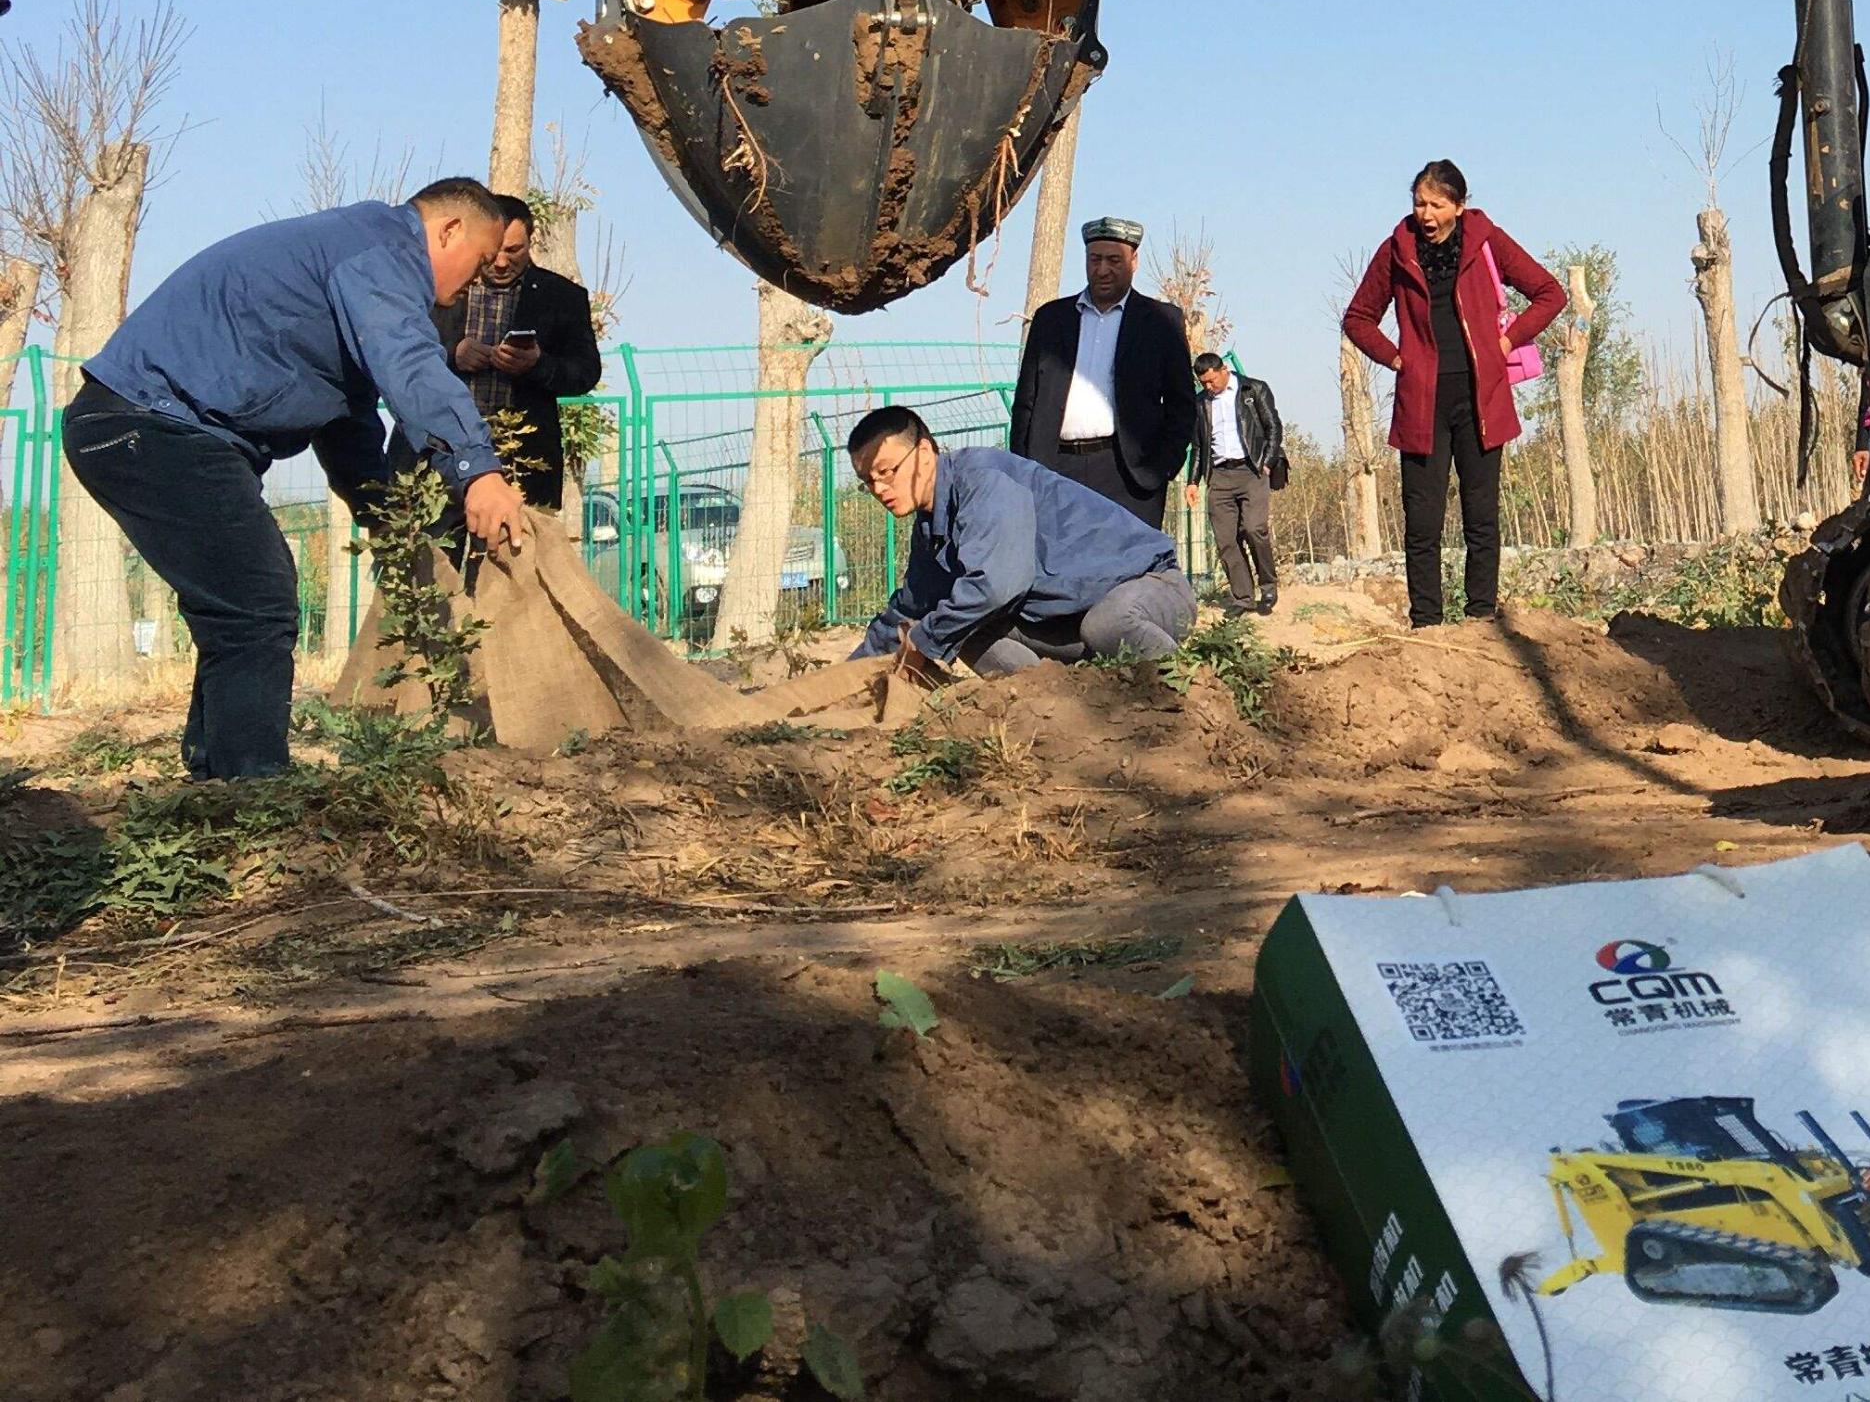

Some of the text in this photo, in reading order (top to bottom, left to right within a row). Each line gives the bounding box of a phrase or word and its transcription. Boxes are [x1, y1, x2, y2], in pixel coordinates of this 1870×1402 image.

[1588, 972, 1723, 1005] CQM
[1604, 999, 1736, 1026] 常青机械
